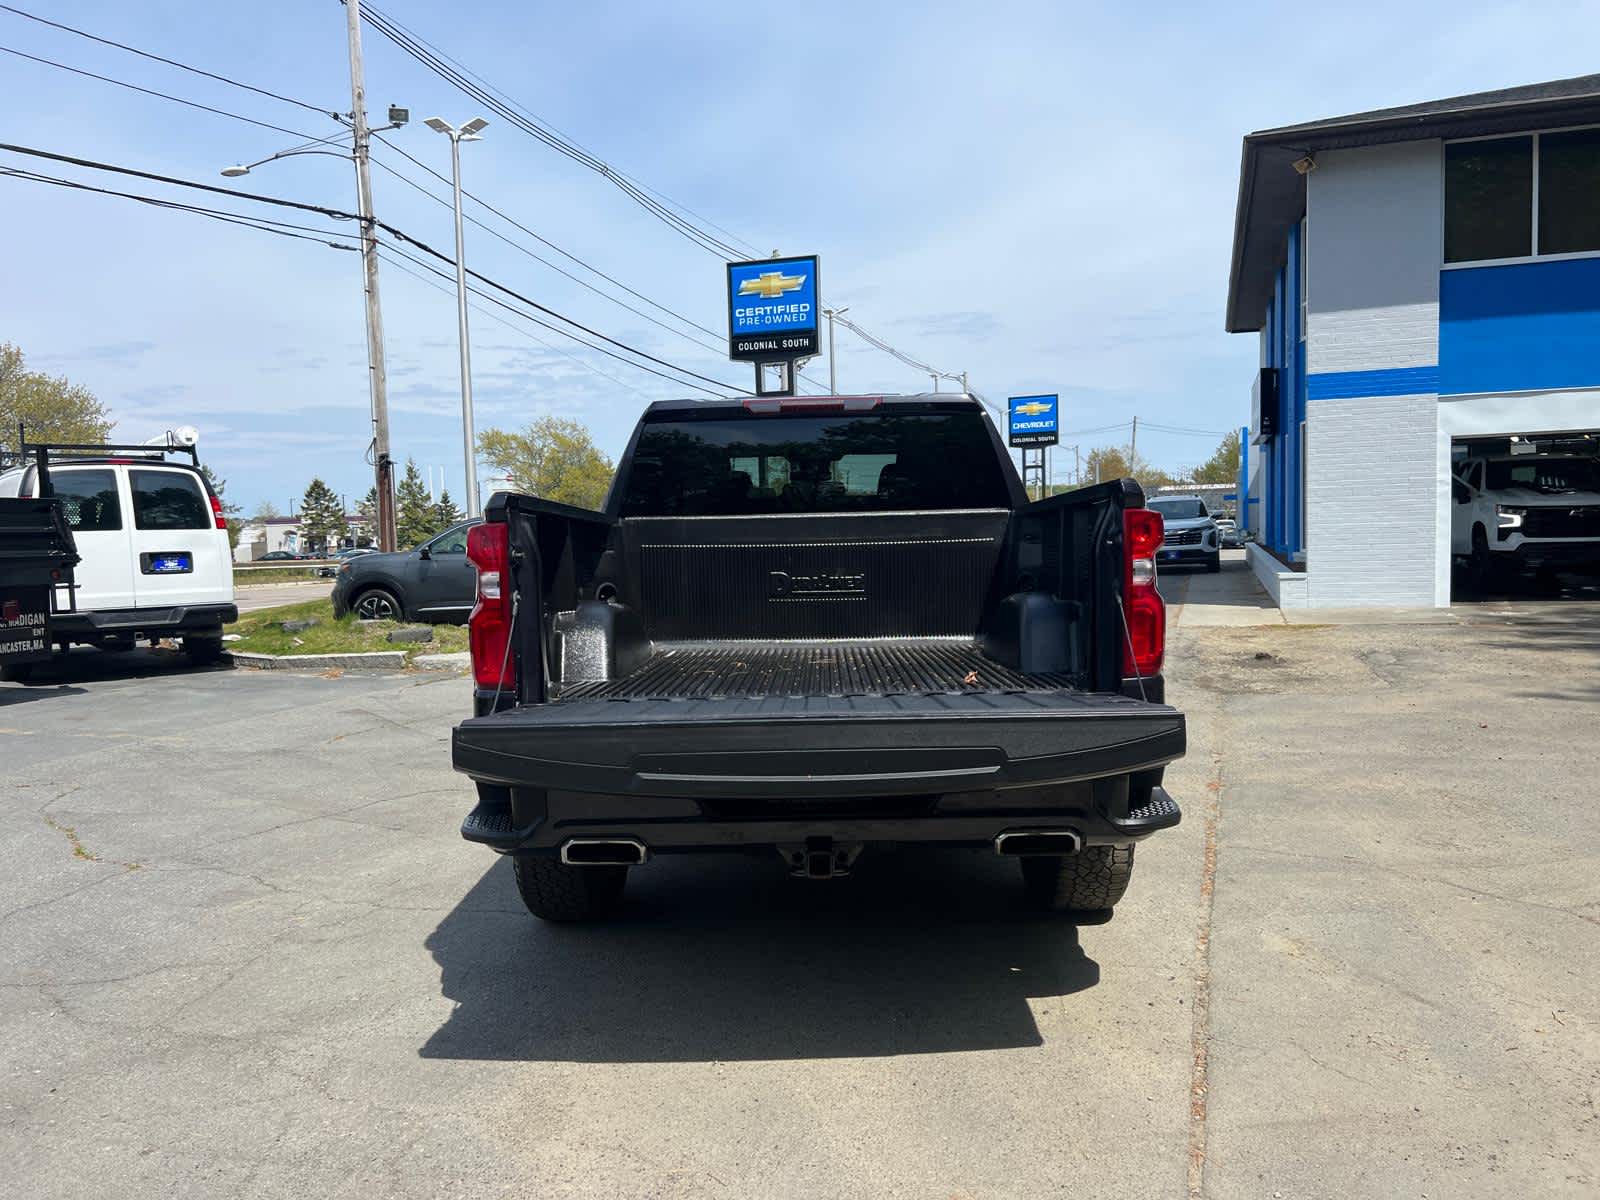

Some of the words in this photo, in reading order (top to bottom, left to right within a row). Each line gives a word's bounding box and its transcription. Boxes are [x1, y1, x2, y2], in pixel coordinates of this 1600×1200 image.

[735, 303, 810, 317] CERTIFIED
[739, 312, 807, 326] PRE-OWNED
[738, 340, 778, 351] COLONIAL
[782, 338, 809, 348] SOUTH
[1012, 420, 1055, 430] CHEVROLET
[33, 627, 45, 637] ENT
